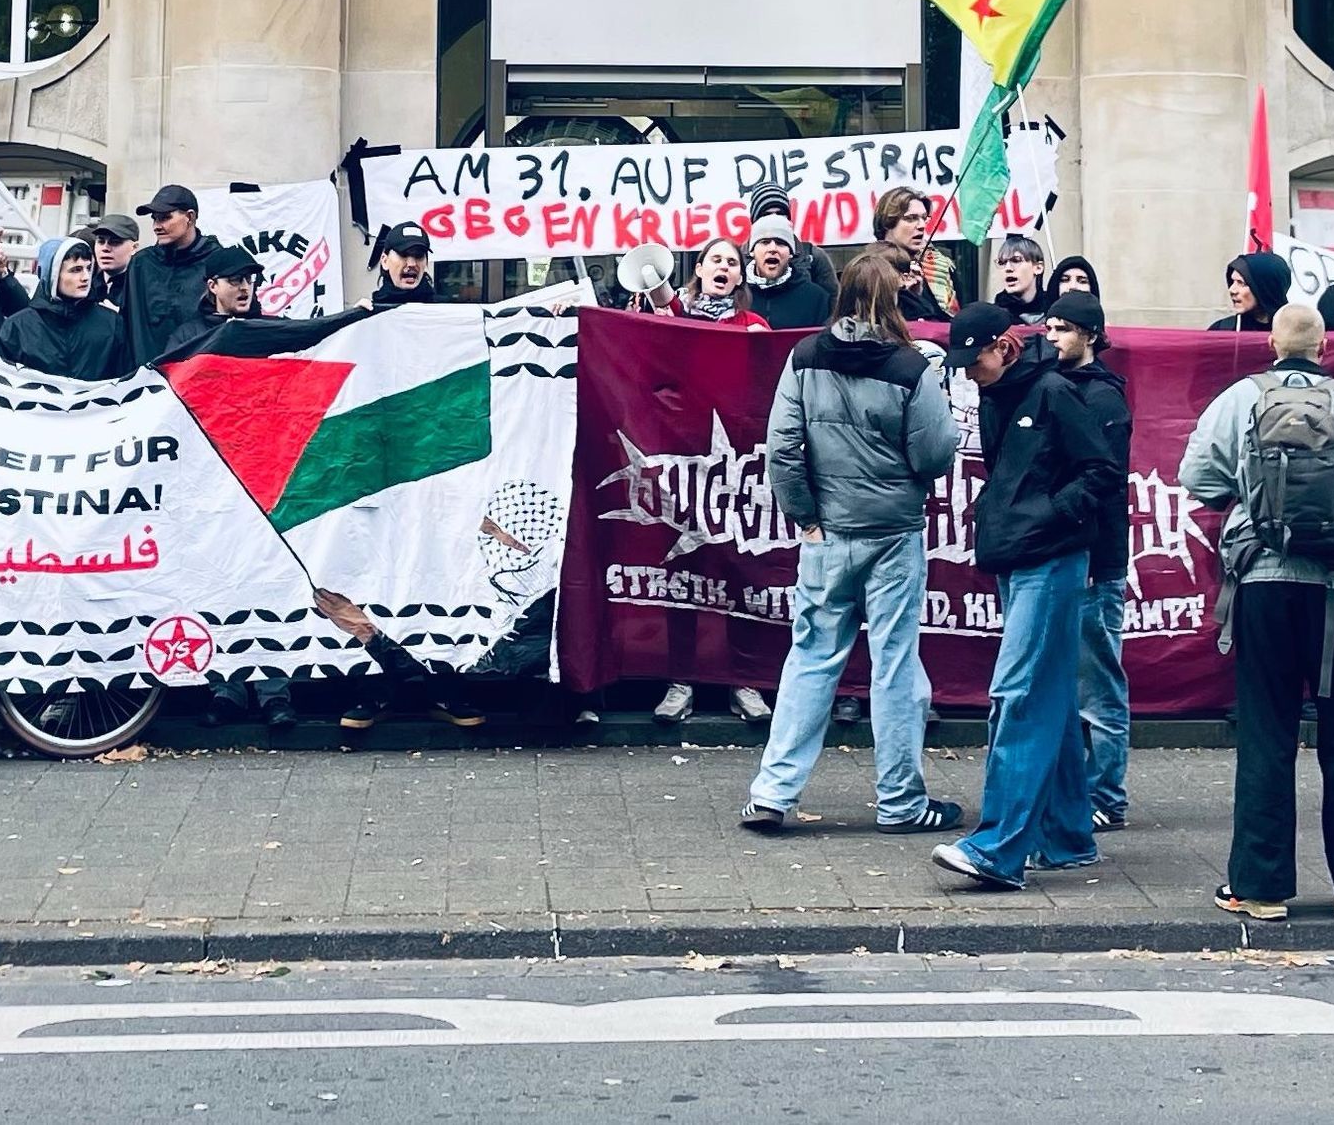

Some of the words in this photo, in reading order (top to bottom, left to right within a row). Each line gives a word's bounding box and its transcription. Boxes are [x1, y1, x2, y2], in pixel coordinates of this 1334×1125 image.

[403, 152, 491, 197] AM
[516, 150, 592, 201] 31.
[611, 156, 709, 205] AUF
[734, 149, 809, 198] DIE
[822, 141, 960, 190] STRAS
[420, 198, 601, 248] GEGEN
[613, 201, 752, 249] KRIEG
[86, 435, 179, 473] FÜR
[164, 640, 191, 663] YS
